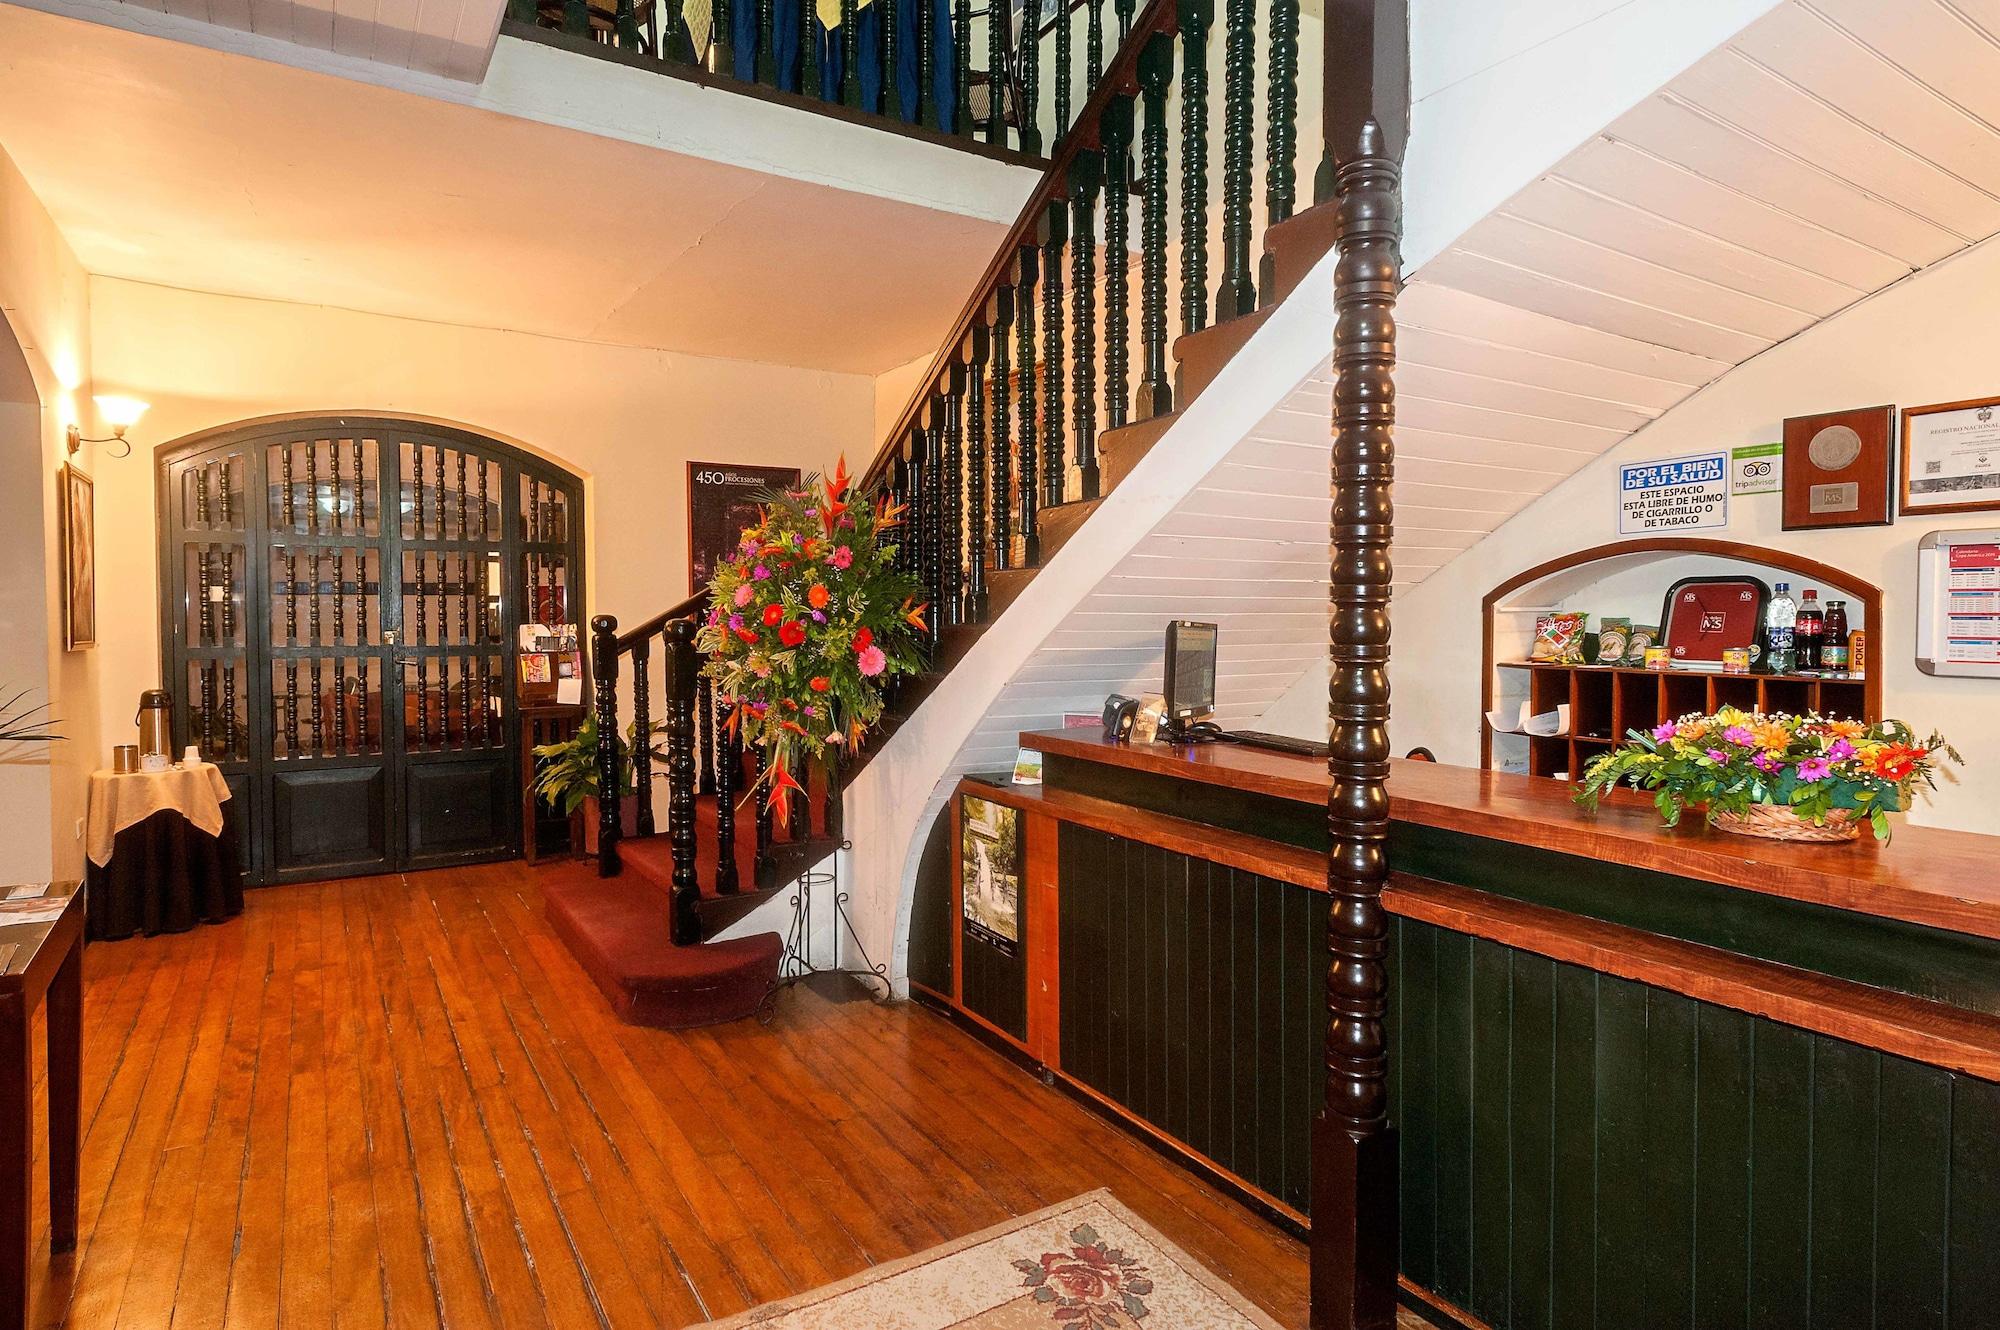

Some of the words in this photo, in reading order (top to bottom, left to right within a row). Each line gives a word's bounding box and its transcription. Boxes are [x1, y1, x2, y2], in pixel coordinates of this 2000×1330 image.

[1627, 468, 1657, 480] POR
[1661, 465, 1679, 476] EL
[1682, 459, 1719, 473] BIEN
[695, 471, 725, 485] 450
[1625, 479, 1645, 489] DE
[1647, 476, 1667, 487] SU
[1669, 469, 1721, 484] SALUD
[1640, 489, 1662, 500] ESTE
[1663, 485, 1705, 497] ESPACIO
[1623, 501, 1646, 511] ESTA
[1648, 499, 1674, 508] LIBRE
[1676, 497, 1689, 506] DE
[1691, 493, 1723, 504] HUMO
[1632, 511, 1644, 519] DE
[1646, 505, 1703, 518] CIGARRILLO
[1705, 504, 1713, 513] O
[1644, 519, 1657, 528] DE
[1658, 516, 1699, 527] TABACO
[1855, 636, 1864, 666] POKER
